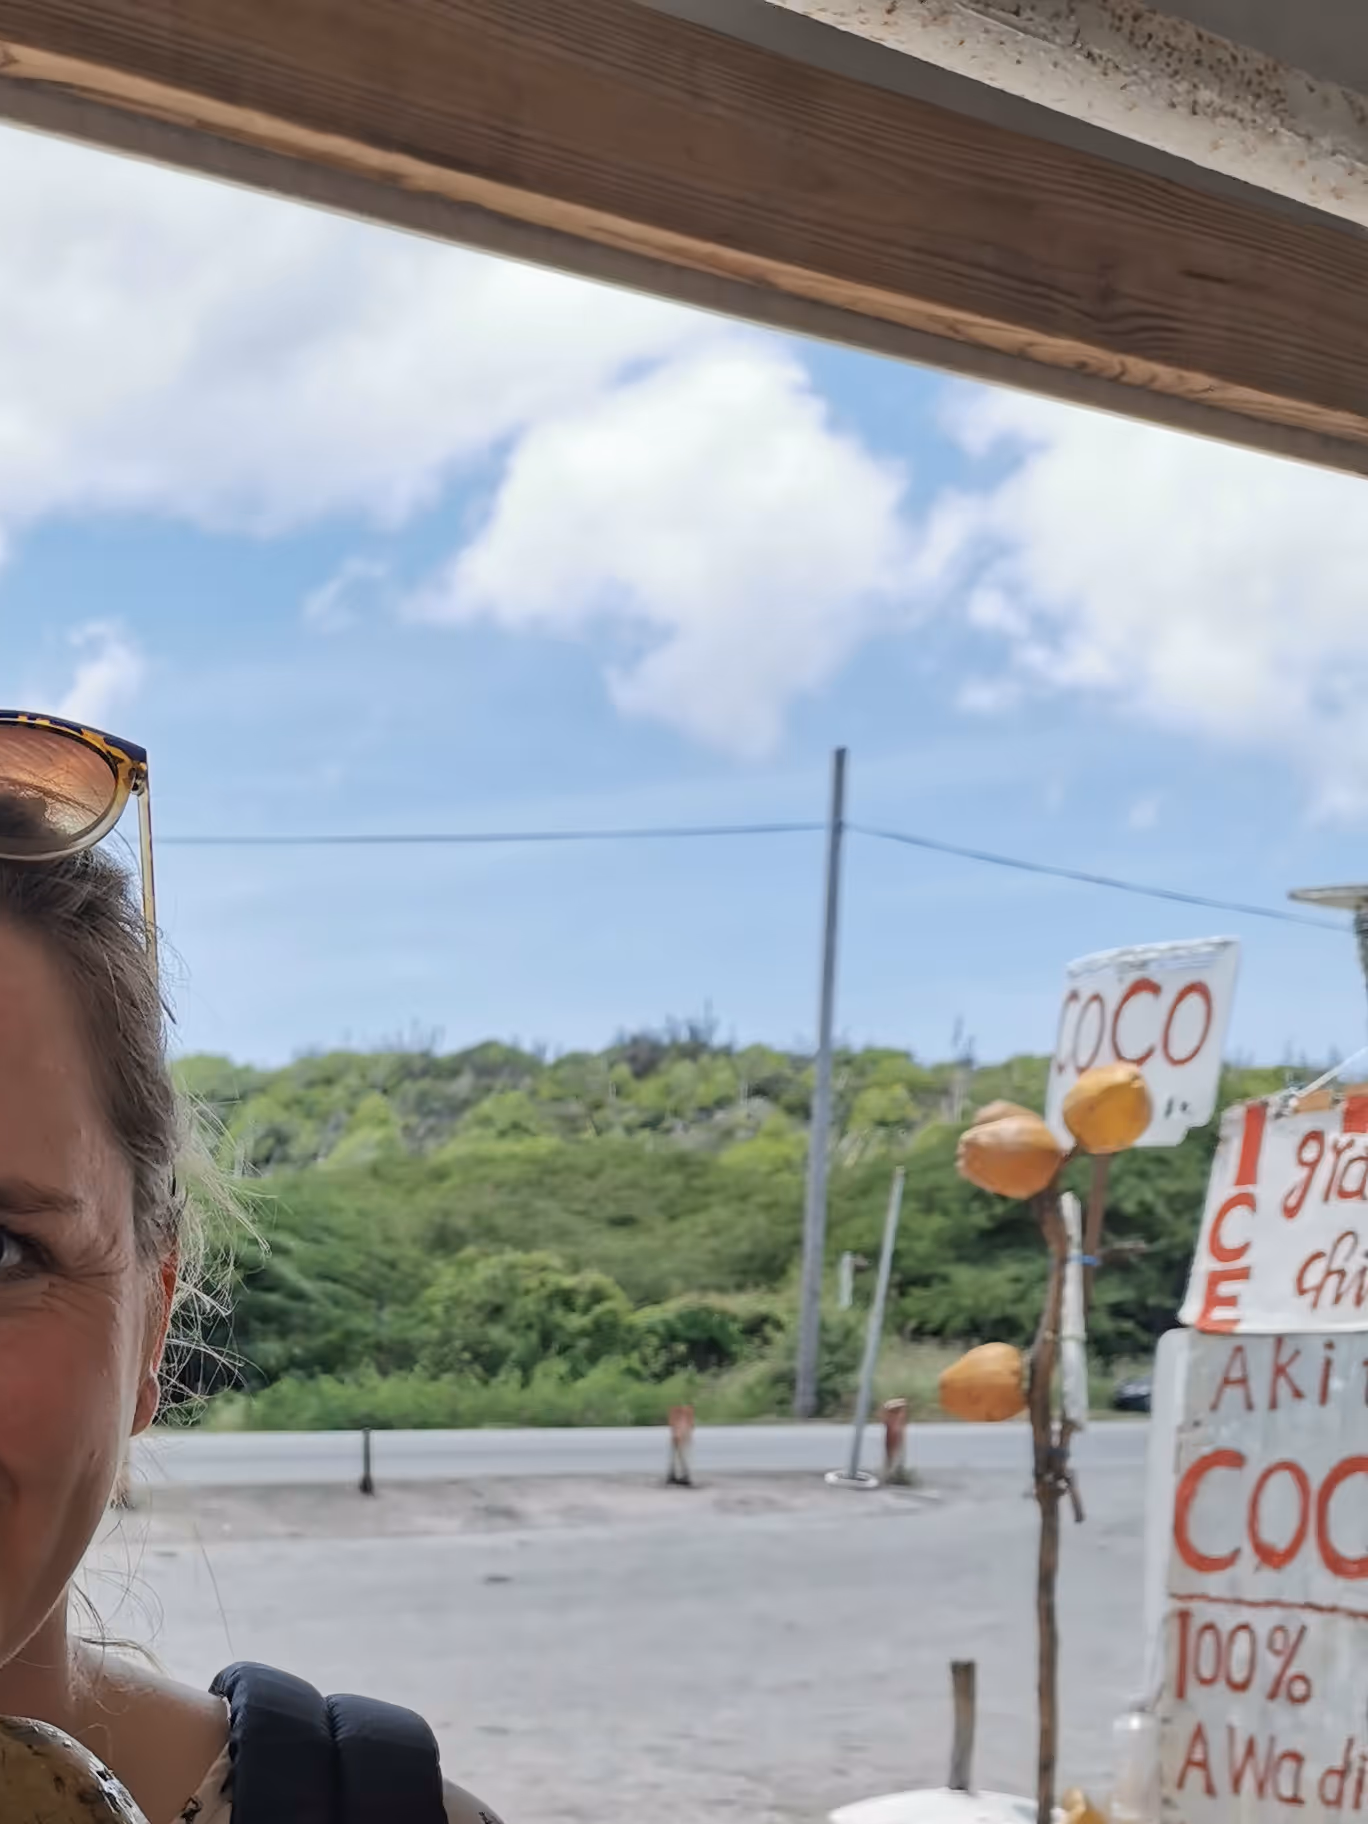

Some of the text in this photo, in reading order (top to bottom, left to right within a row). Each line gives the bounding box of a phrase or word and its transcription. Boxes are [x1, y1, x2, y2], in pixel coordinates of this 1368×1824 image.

[1056, 978, 1213, 1073] COCO
[1195, 1104, 1268, 1334] ICE
[1175, 1609, 1312, 1704] 100%
